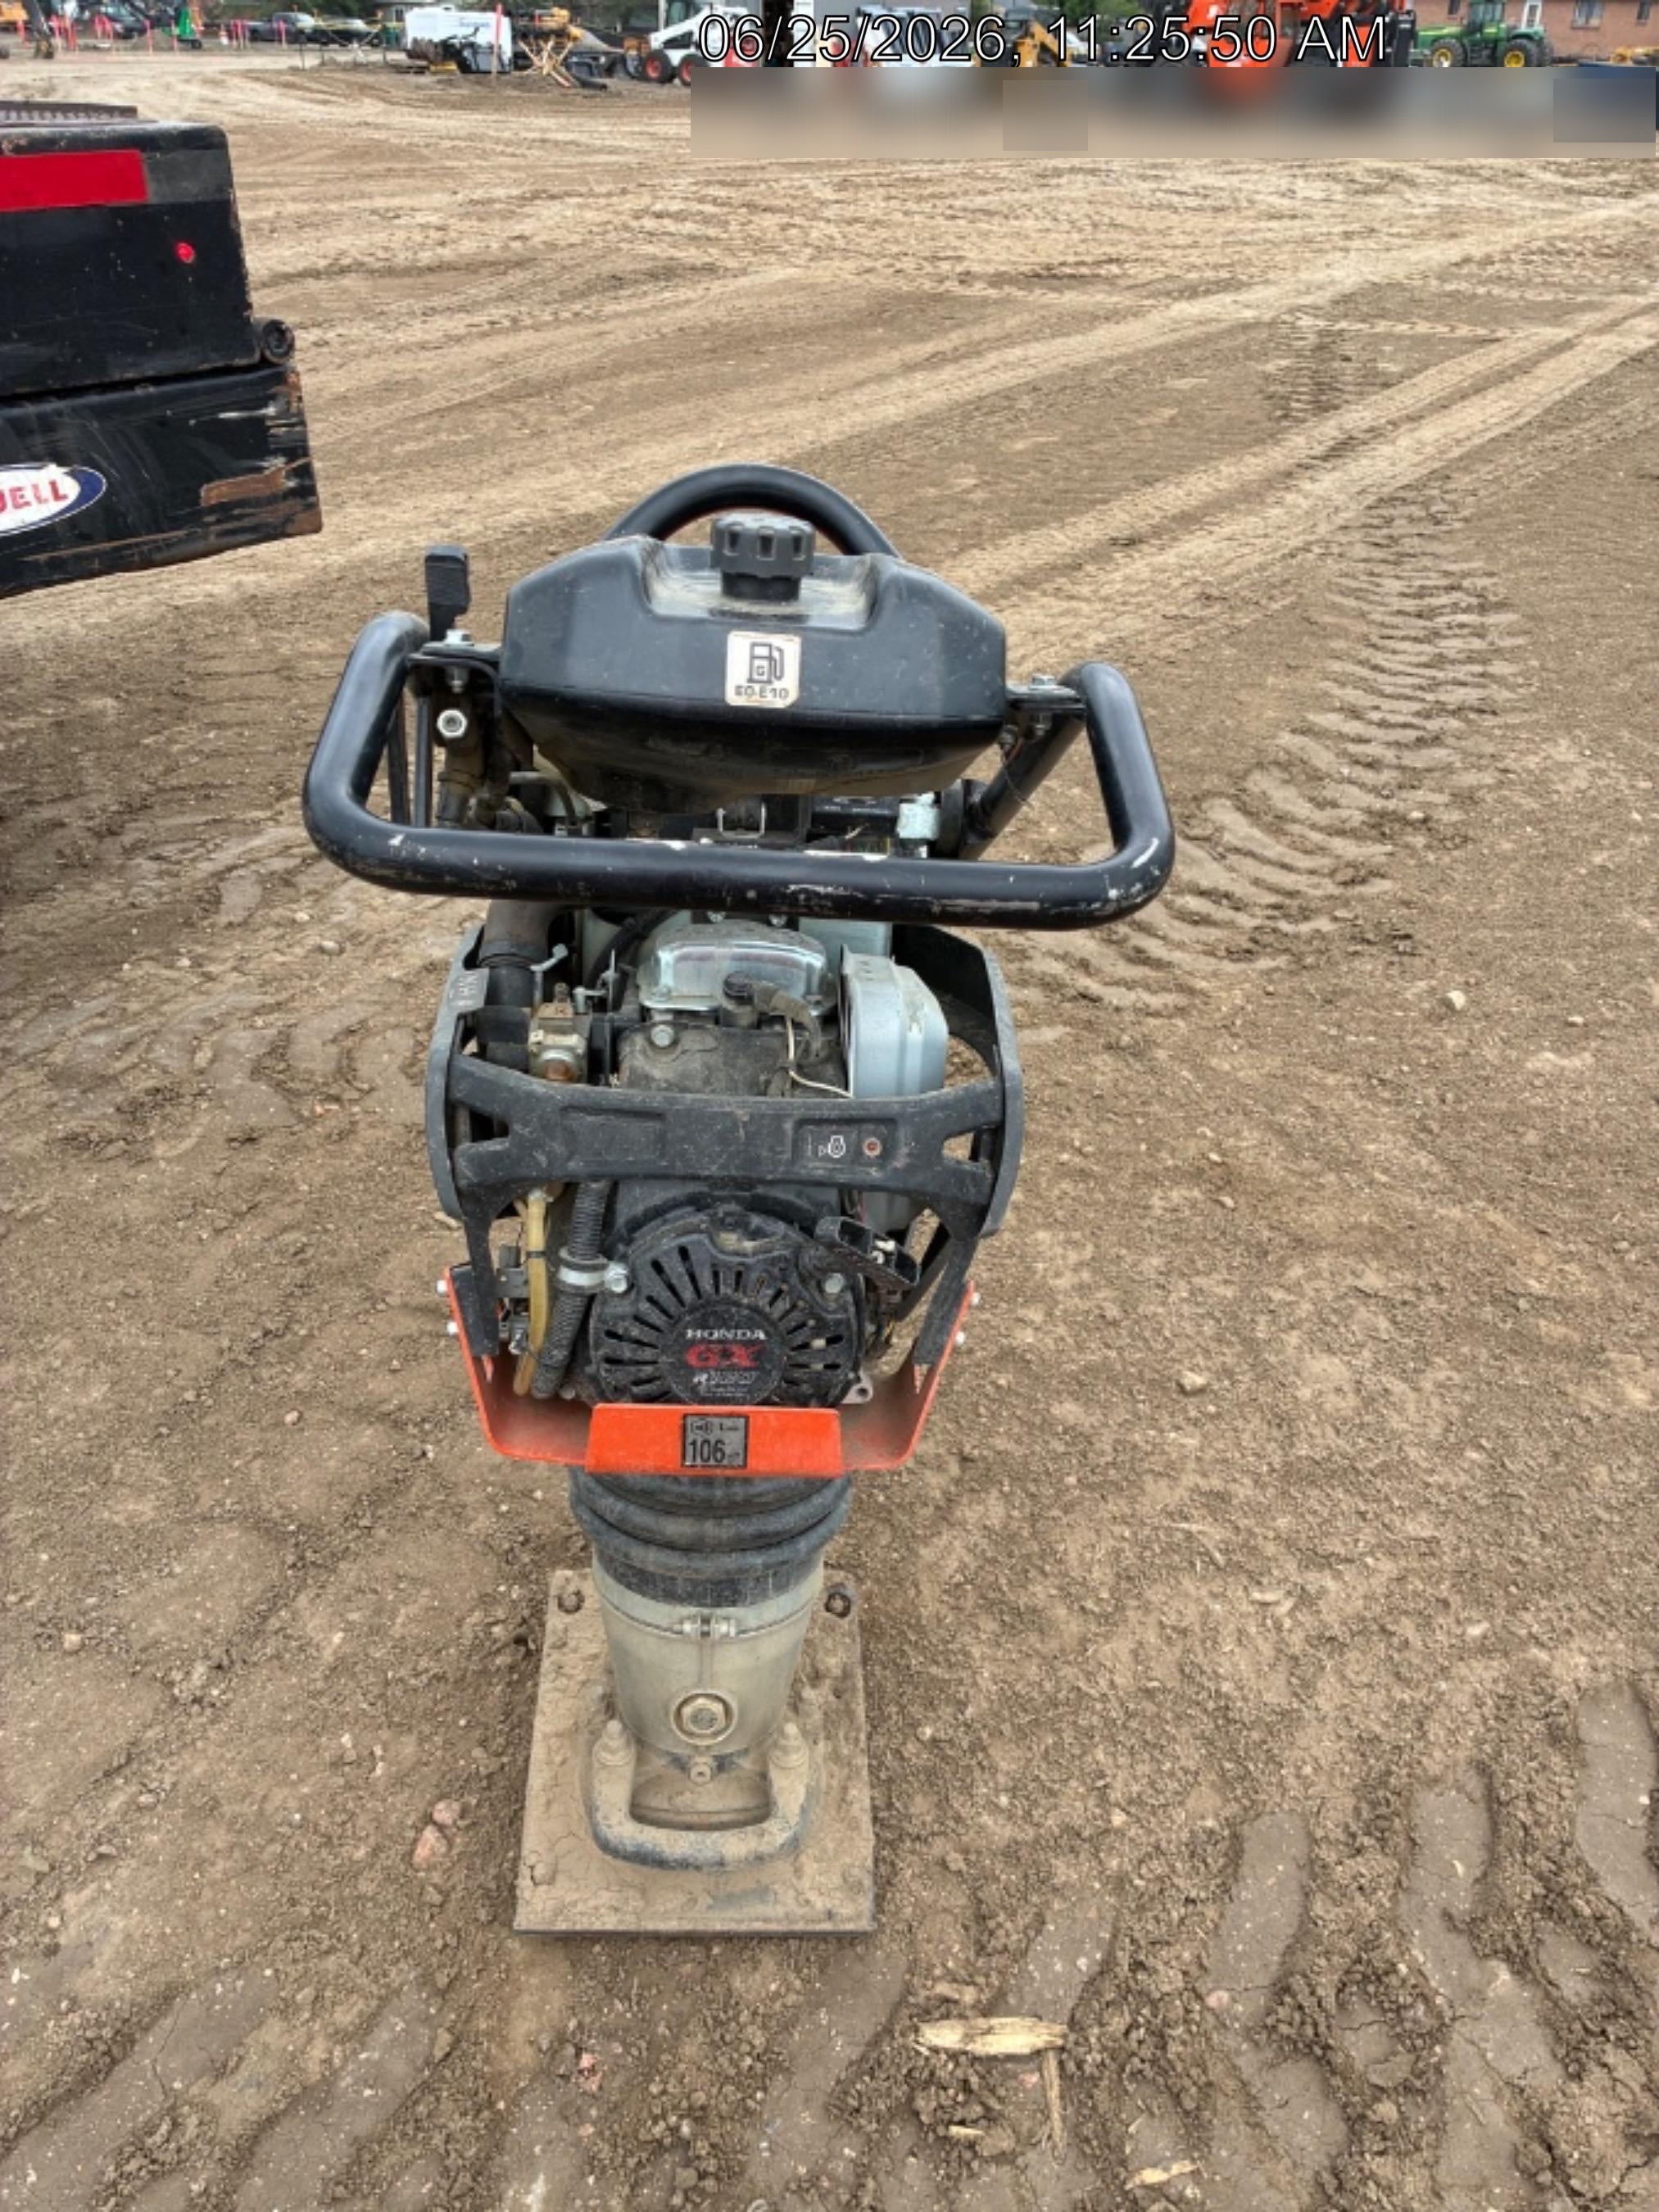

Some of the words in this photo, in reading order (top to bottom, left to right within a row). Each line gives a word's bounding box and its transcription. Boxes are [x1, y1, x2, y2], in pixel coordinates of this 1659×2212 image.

[685, 1328, 767, 1340] HONDA
[685, 1342, 765, 1370] GX
[688, 1439, 726, 1462] 106
